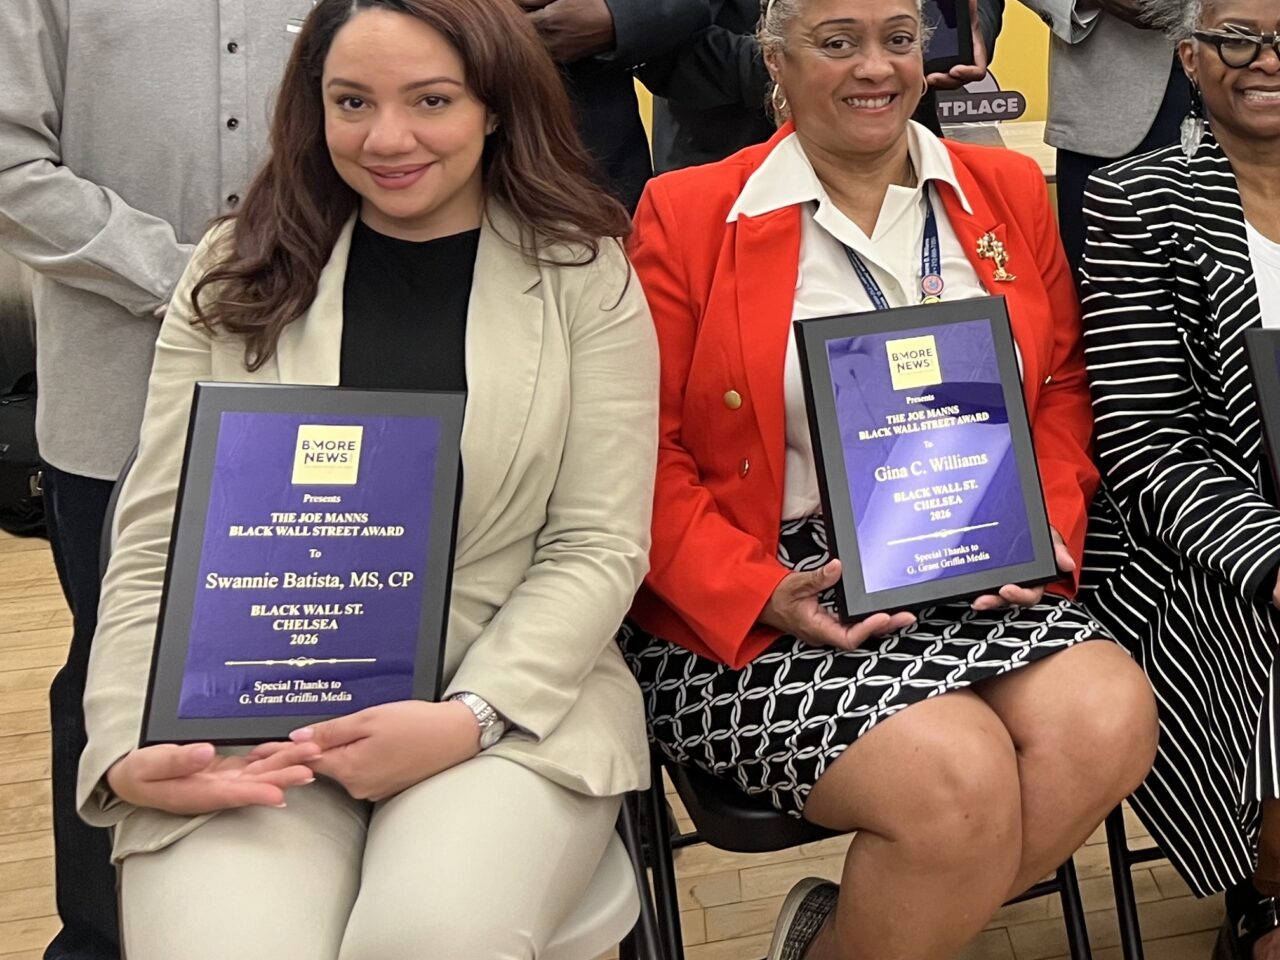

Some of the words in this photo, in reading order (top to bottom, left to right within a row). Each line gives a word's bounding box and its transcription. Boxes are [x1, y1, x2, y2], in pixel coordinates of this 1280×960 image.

[897, 359, 930, 373] NEWS
[906, 394, 935, 405] Presents
[886, 414, 906, 425] THE
[907, 411, 926, 422] JOE
[927, 405, 960, 419] MANNS
[859, 428, 893, 441] BLACK
[894, 424, 921, 435] WALL
[920, 418, 957, 433] STREET
[957, 412, 990, 424] AWARD
[303, 452, 348, 465] NEWS
[874, 466, 908, 483] Gina
[910, 462, 927, 476] C.
[929, 452, 988, 474] Williams
[894, 490, 932, 503] BLACK
[932, 483, 963, 496] WALL
[963, 480, 978, 491] ST.
[303, 494, 341, 504] Presents
[914, 496, 963, 512] CHELSEA
[270, 513, 297, 523] THE
[298, 513, 322, 524] JOE
[324, 513, 368, 523] MANNS
[930, 509, 951, 521] 2026
[229, 526, 273, 537] BLACK
[275, 526, 311, 536] WALL
[312, 526, 360, 536] STREET
[361, 526, 404, 536] AWARD
[309, 549, 322, 559] To
[205, 572, 279, 589] Swannie
[283, 572, 344, 590] Batista,
[349, 572, 383, 590] MS,
[389, 571, 414, 588] CP
[251, 605, 300, 617] BLACK
[303, 604, 343, 615] WALL
[344, 604, 364, 615] ST.
[273, 619, 339, 630] CHELSEA
[290, 634, 318, 645] 2026
[254, 680, 291, 692] Special
[293, 680, 329, 691] Thanks
[331, 680, 341, 690] to
[240, 695, 252, 705] G.
[255, 693, 283, 704] Grant
[285, 692, 319, 703] Griffin
[321, 692, 352, 702] Media
